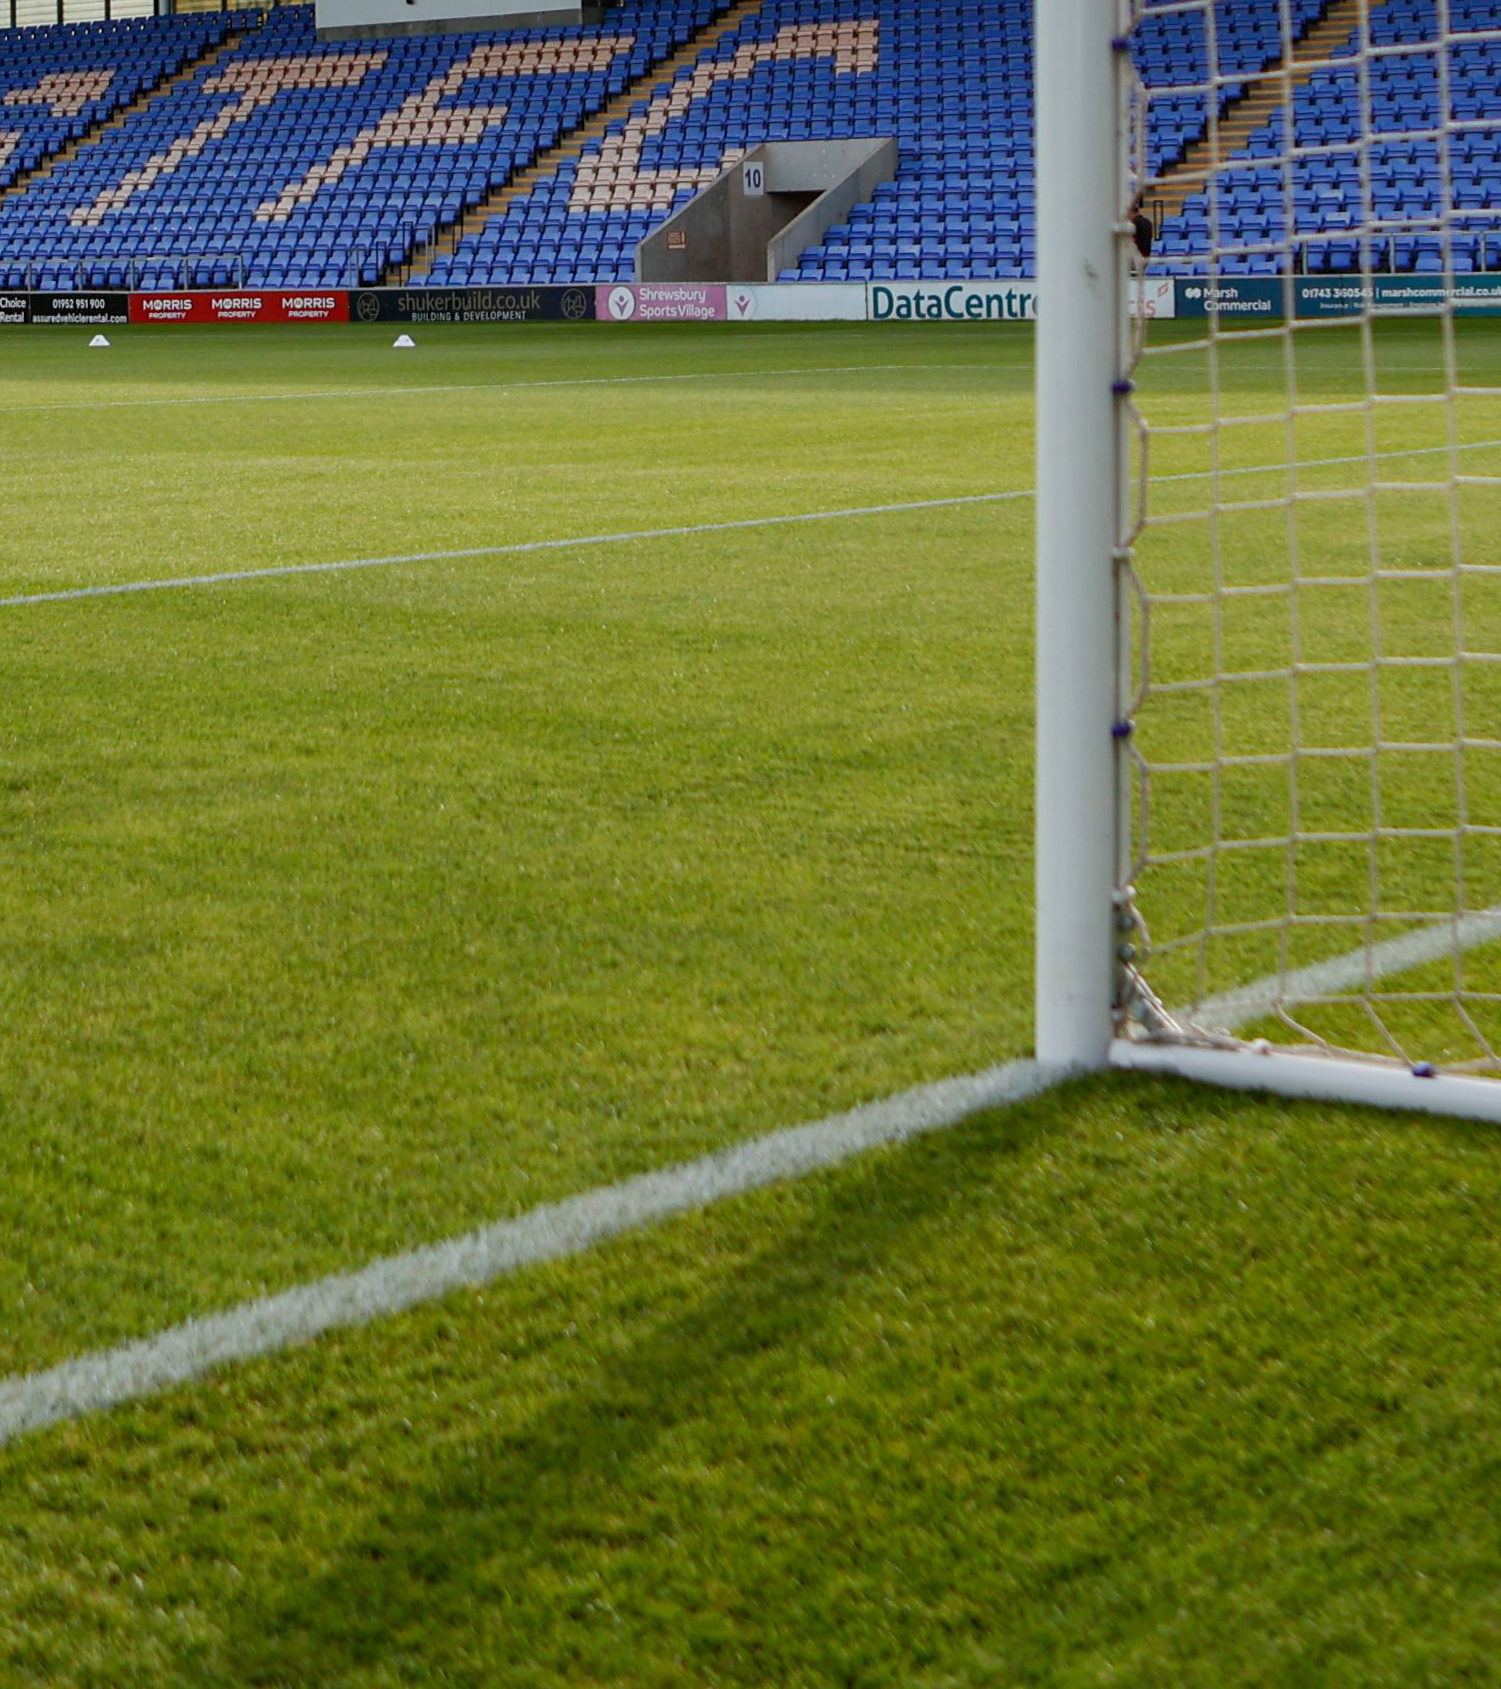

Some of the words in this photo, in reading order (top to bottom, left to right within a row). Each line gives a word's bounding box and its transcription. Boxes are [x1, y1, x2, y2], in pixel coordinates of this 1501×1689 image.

[745, 169, 761, 188] 10
[639, 287, 706, 303] Shrewsbury
[1203, 287, 1238, 299] Marsh
[1302, 288, 1331, 298] 01743
[0, 297, 26, 308] Choice
[53, 299, 74, 309] 01952
[76, 299, 88, 309] 951
[90, 299, 105, 309] 900
[143, 299, 192, 310] MORRIS
[211, 298, 262, 309] MORRIS
[282, 297, 335, 309] MORRIS
[399, 290, 541, 312] shukerbuild.co.uk
[1204, 300, 1271, 311] Commercial
[0, 311, 24, 322] Rental
[218, 310, 256, 318] PROPERTY
[288, 310, 329, 318] PROPERTY
[412, 312, 452, 322] BUILDING
[454, 312, 461, 321] &
[463, 310, 526, 321] DEVELOPMENT
[639, 304, 676, 319] Sports
[677, 304, 715, 319] Village
[32, 313, 127, 324] assuredvehiclerental.com
